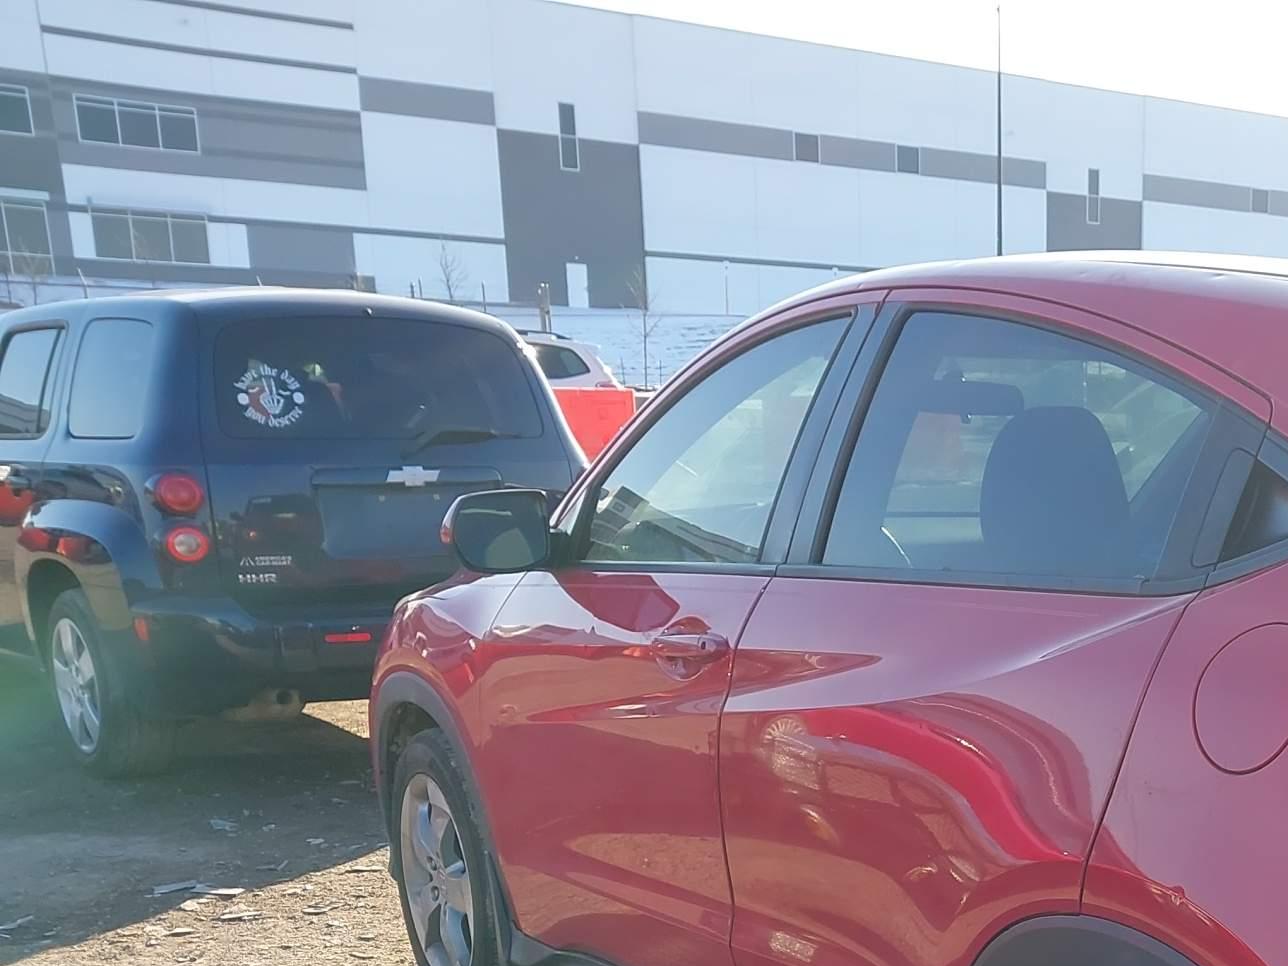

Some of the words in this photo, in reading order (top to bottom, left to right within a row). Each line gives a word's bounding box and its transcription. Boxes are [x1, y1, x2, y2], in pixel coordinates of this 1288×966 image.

[260, 363, 278, 376] the
[280, 369, 300, 390] day
[244, 406, 266, 425] you
[268, 406, 302, 427] deserve
[238, 573, 277, 584] HHR
